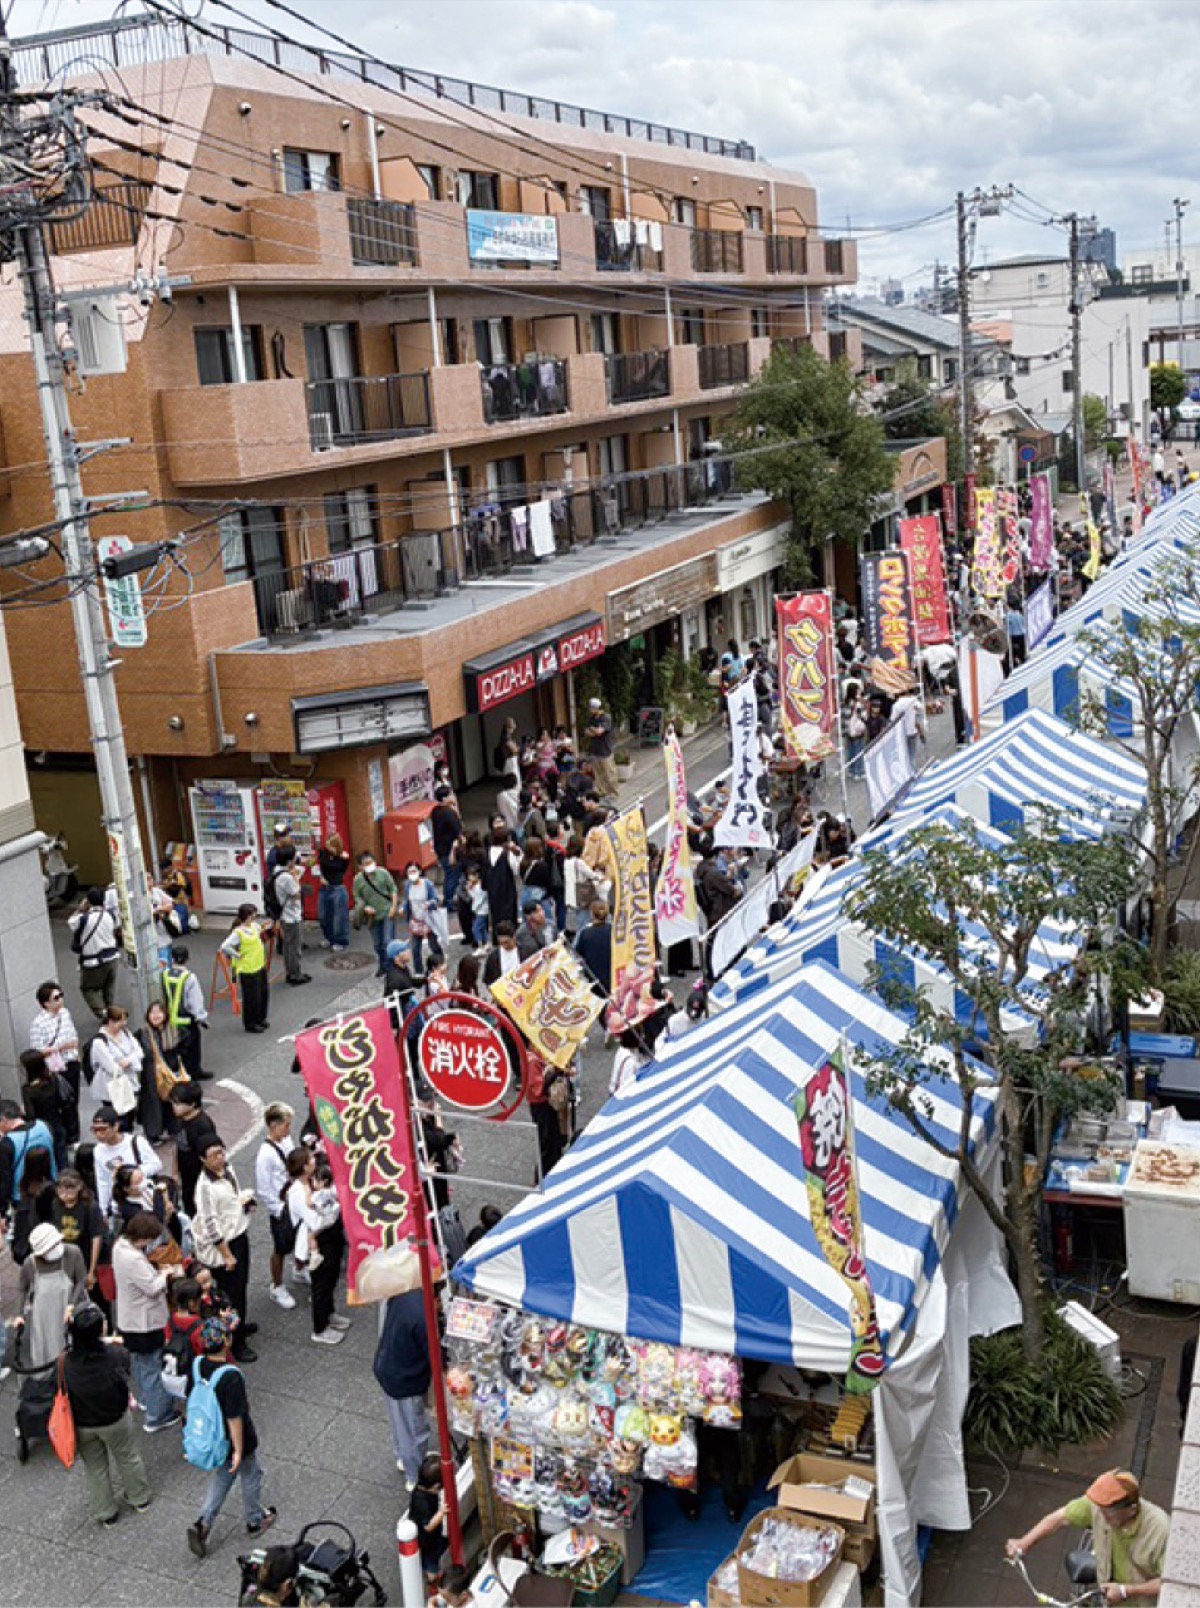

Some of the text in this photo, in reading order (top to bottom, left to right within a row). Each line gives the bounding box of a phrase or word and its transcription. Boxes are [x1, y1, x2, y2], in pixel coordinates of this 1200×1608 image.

[560, 628, 604, 664] PIZZA-LA
[482, 659, 534, 704] PIZZA-LA
[432, 1021, 491, 1039] FIRE HYDRANT
[427, 1037, 502, 1083] 消火栓
